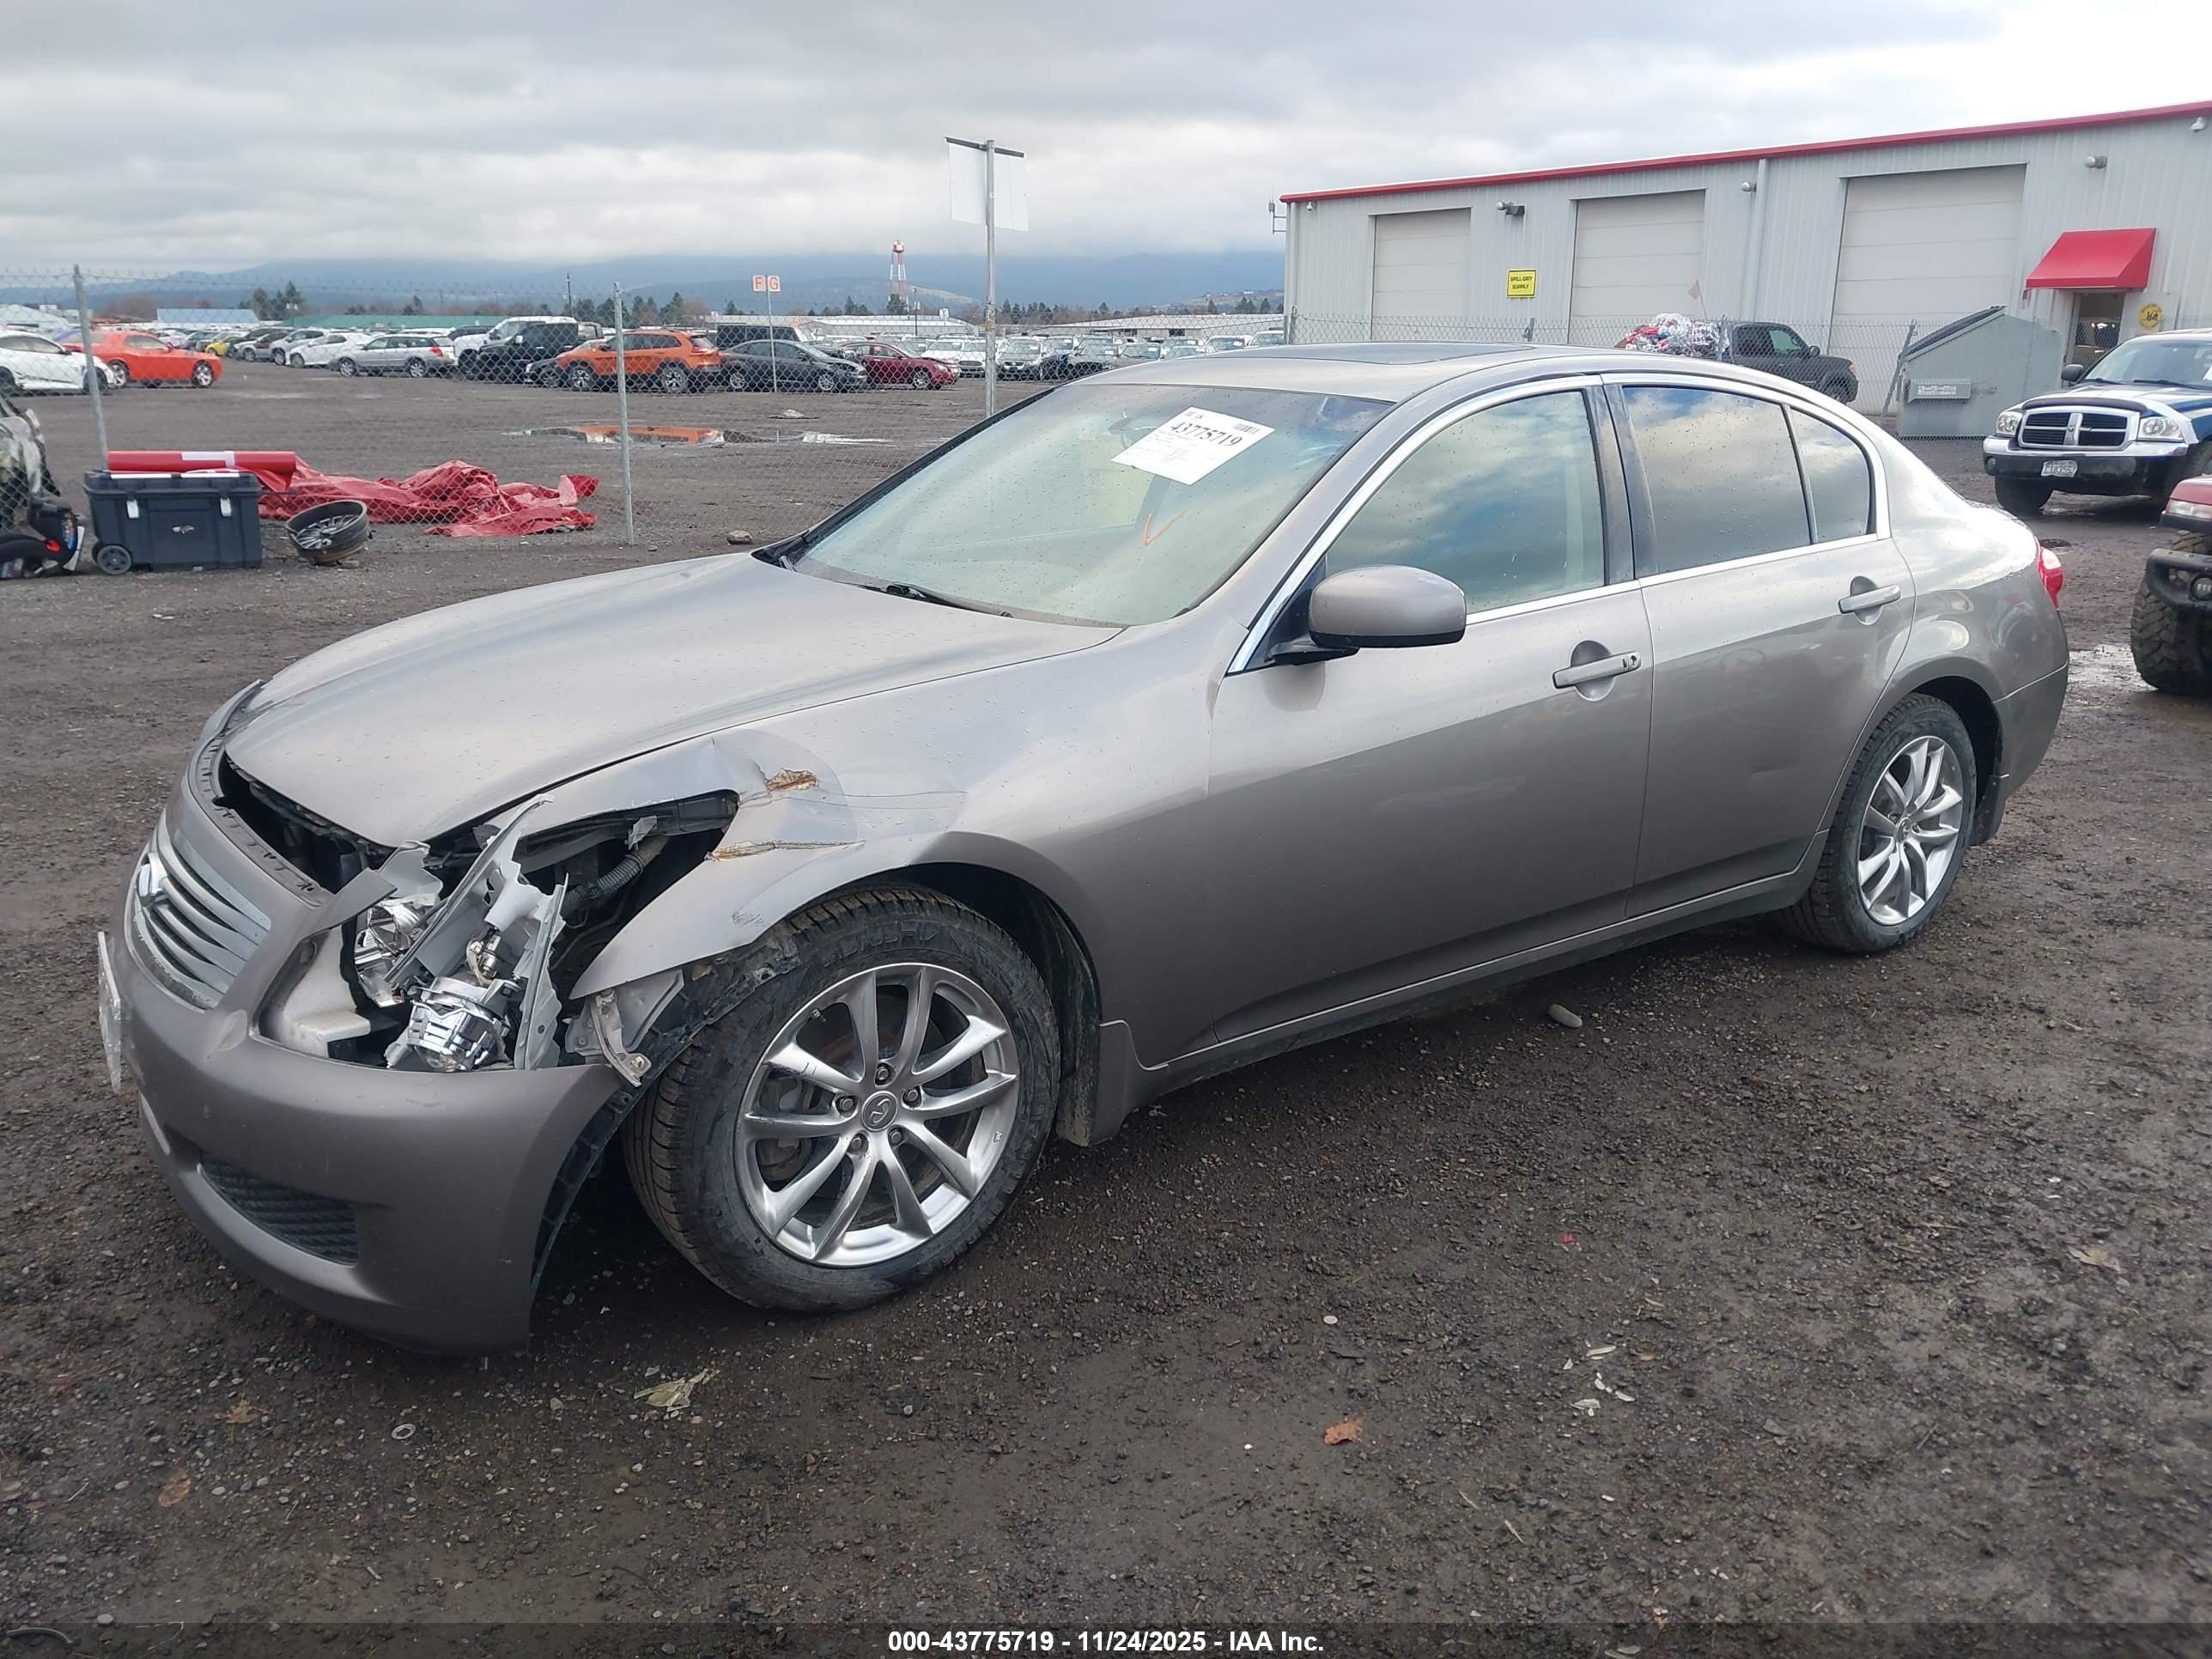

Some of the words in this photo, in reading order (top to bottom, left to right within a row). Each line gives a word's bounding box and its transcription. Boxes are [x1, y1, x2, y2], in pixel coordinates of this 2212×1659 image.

[756, 276, 763, 289] F
[769, 276, 779, 290] G
[1170, 422, 1243, 447] 43775719
